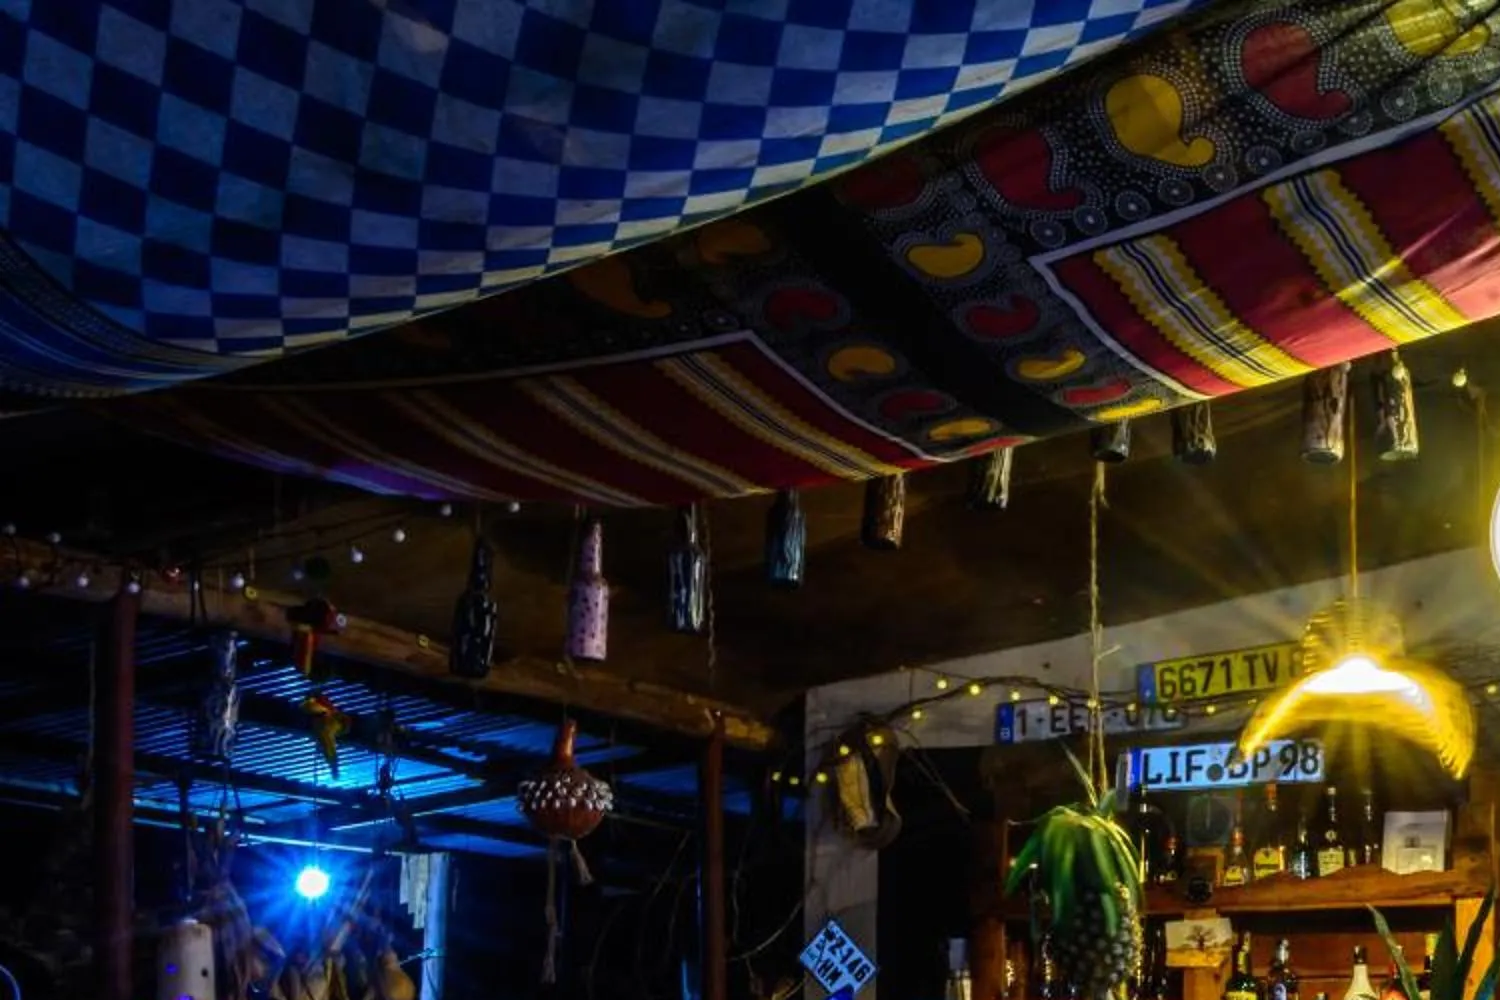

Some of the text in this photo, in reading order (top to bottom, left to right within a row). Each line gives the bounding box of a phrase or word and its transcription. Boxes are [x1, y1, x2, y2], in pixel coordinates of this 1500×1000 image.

[1159, 658, 1233, 698] 6671
[1243, 652, 1279, 686] TV
[1143, 750, 1206, 784] LIF
